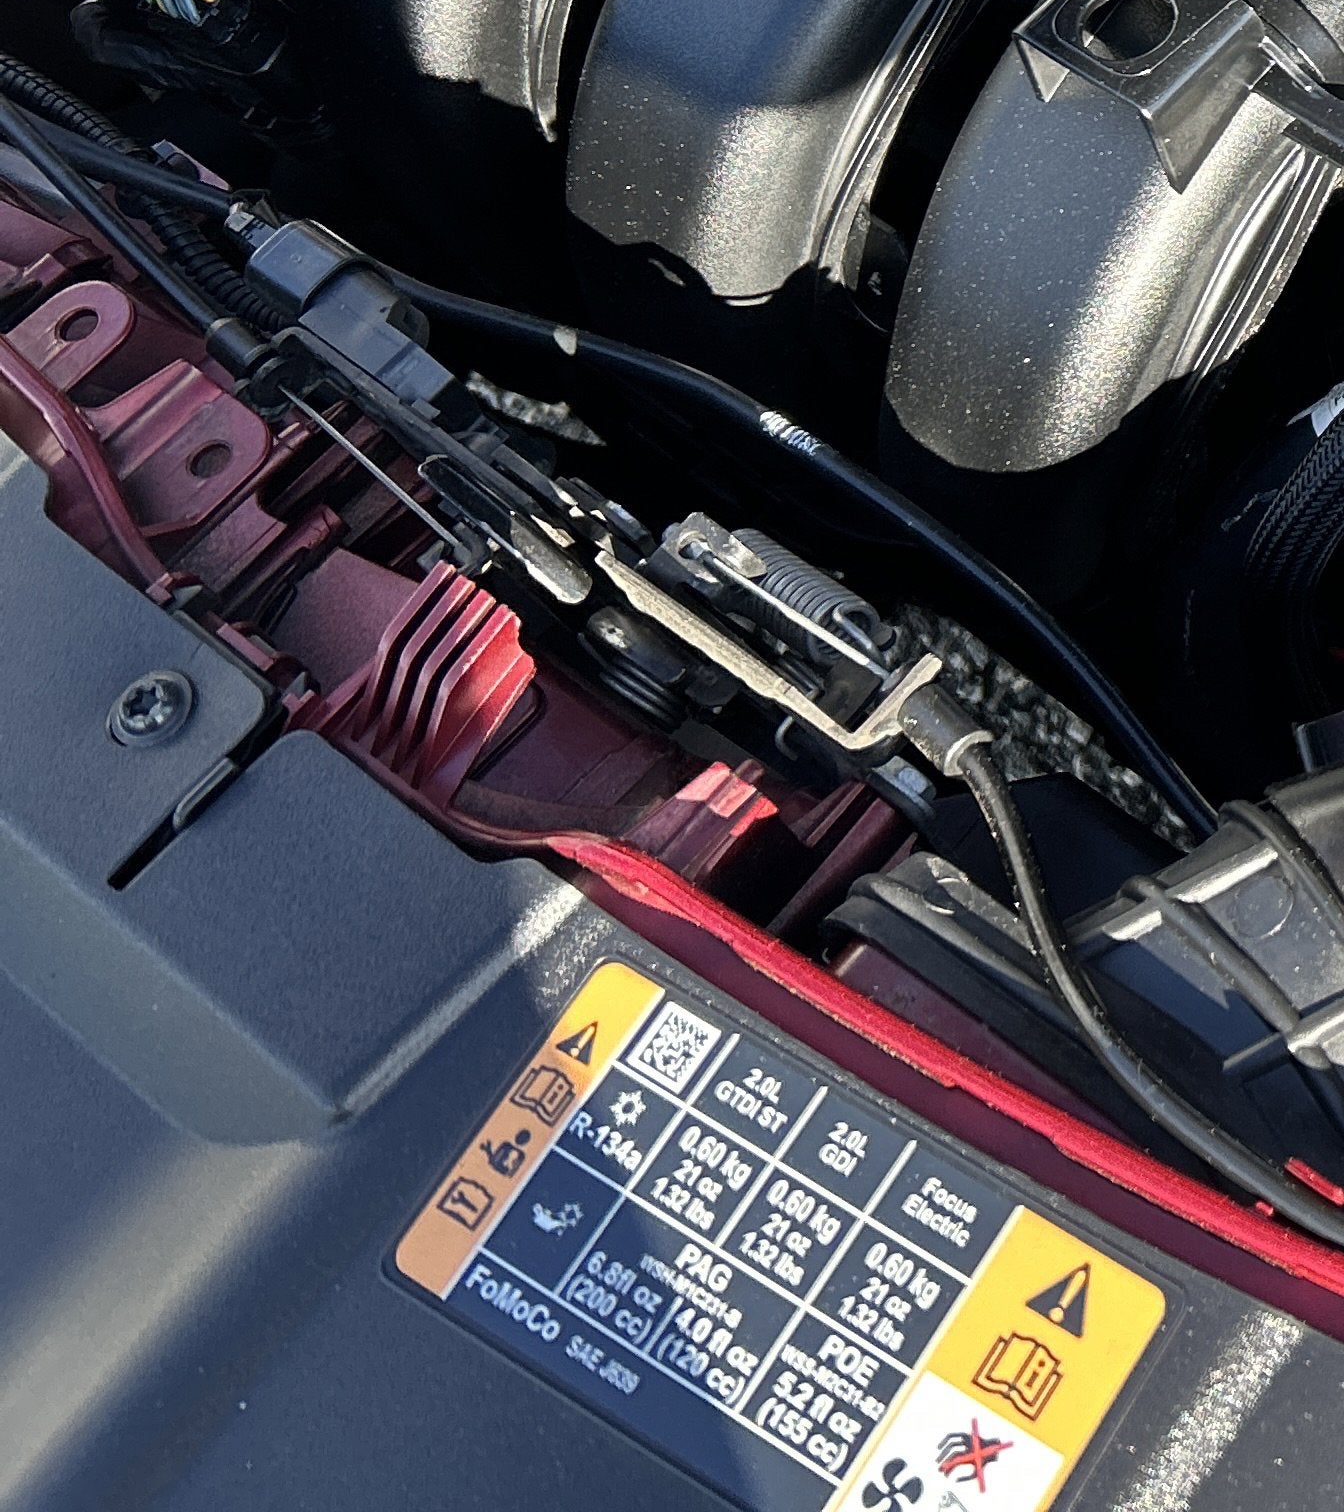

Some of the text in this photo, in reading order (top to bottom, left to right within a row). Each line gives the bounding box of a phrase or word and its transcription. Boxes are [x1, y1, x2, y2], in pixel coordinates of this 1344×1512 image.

[715, 1081, 788, 1133] GTDI ST
[744, 1068, 782, 1104] 2.0L
[571, 1112, 642, 1170] R-134a
[680, 1126, 752, 1190] 0.60 kg
[819, 1144, 857, 1176] GDI
[829, 1122, 867, 1158] 2.0L
[652, 1178, 715, 1230] 1.32 lbs
[673, 1160, 723, 1202] 21 oz
[922, 1178, 977, 1223] Focus
[762, 1214, 812, 1257] 21 oz
[767, 1180, 841, 1245] 0.60 kg
[903, 1194, 969, 1246] Electric
[676, 1244, 732, 1292] PAG
[740, 1232, 804, 1286] 1.32 lbs
[865, 1243, 940, 1310] 0.60 kg
[465, 1263, 560, 1341] FoMoCo
[565, 1336, 602, 1371] SAE
[566, 1276, 652, 1344] (200 cc)
[634, 1286, 663, 1312] oz
[839, 1296, 904, 1351] 1.32 lbs
[860, 1277, 912, 1322] 21 oz
[657, 1334, 745, 1404] (120 cc)
[676, 1309, 758, 1376] 4.0 fl oz
[818, 1335, 880, 1388] POE
[772, 1372, 862, 1443] 5.2 fl oz
[756, 1397, 849, 1472] (155 cc)
